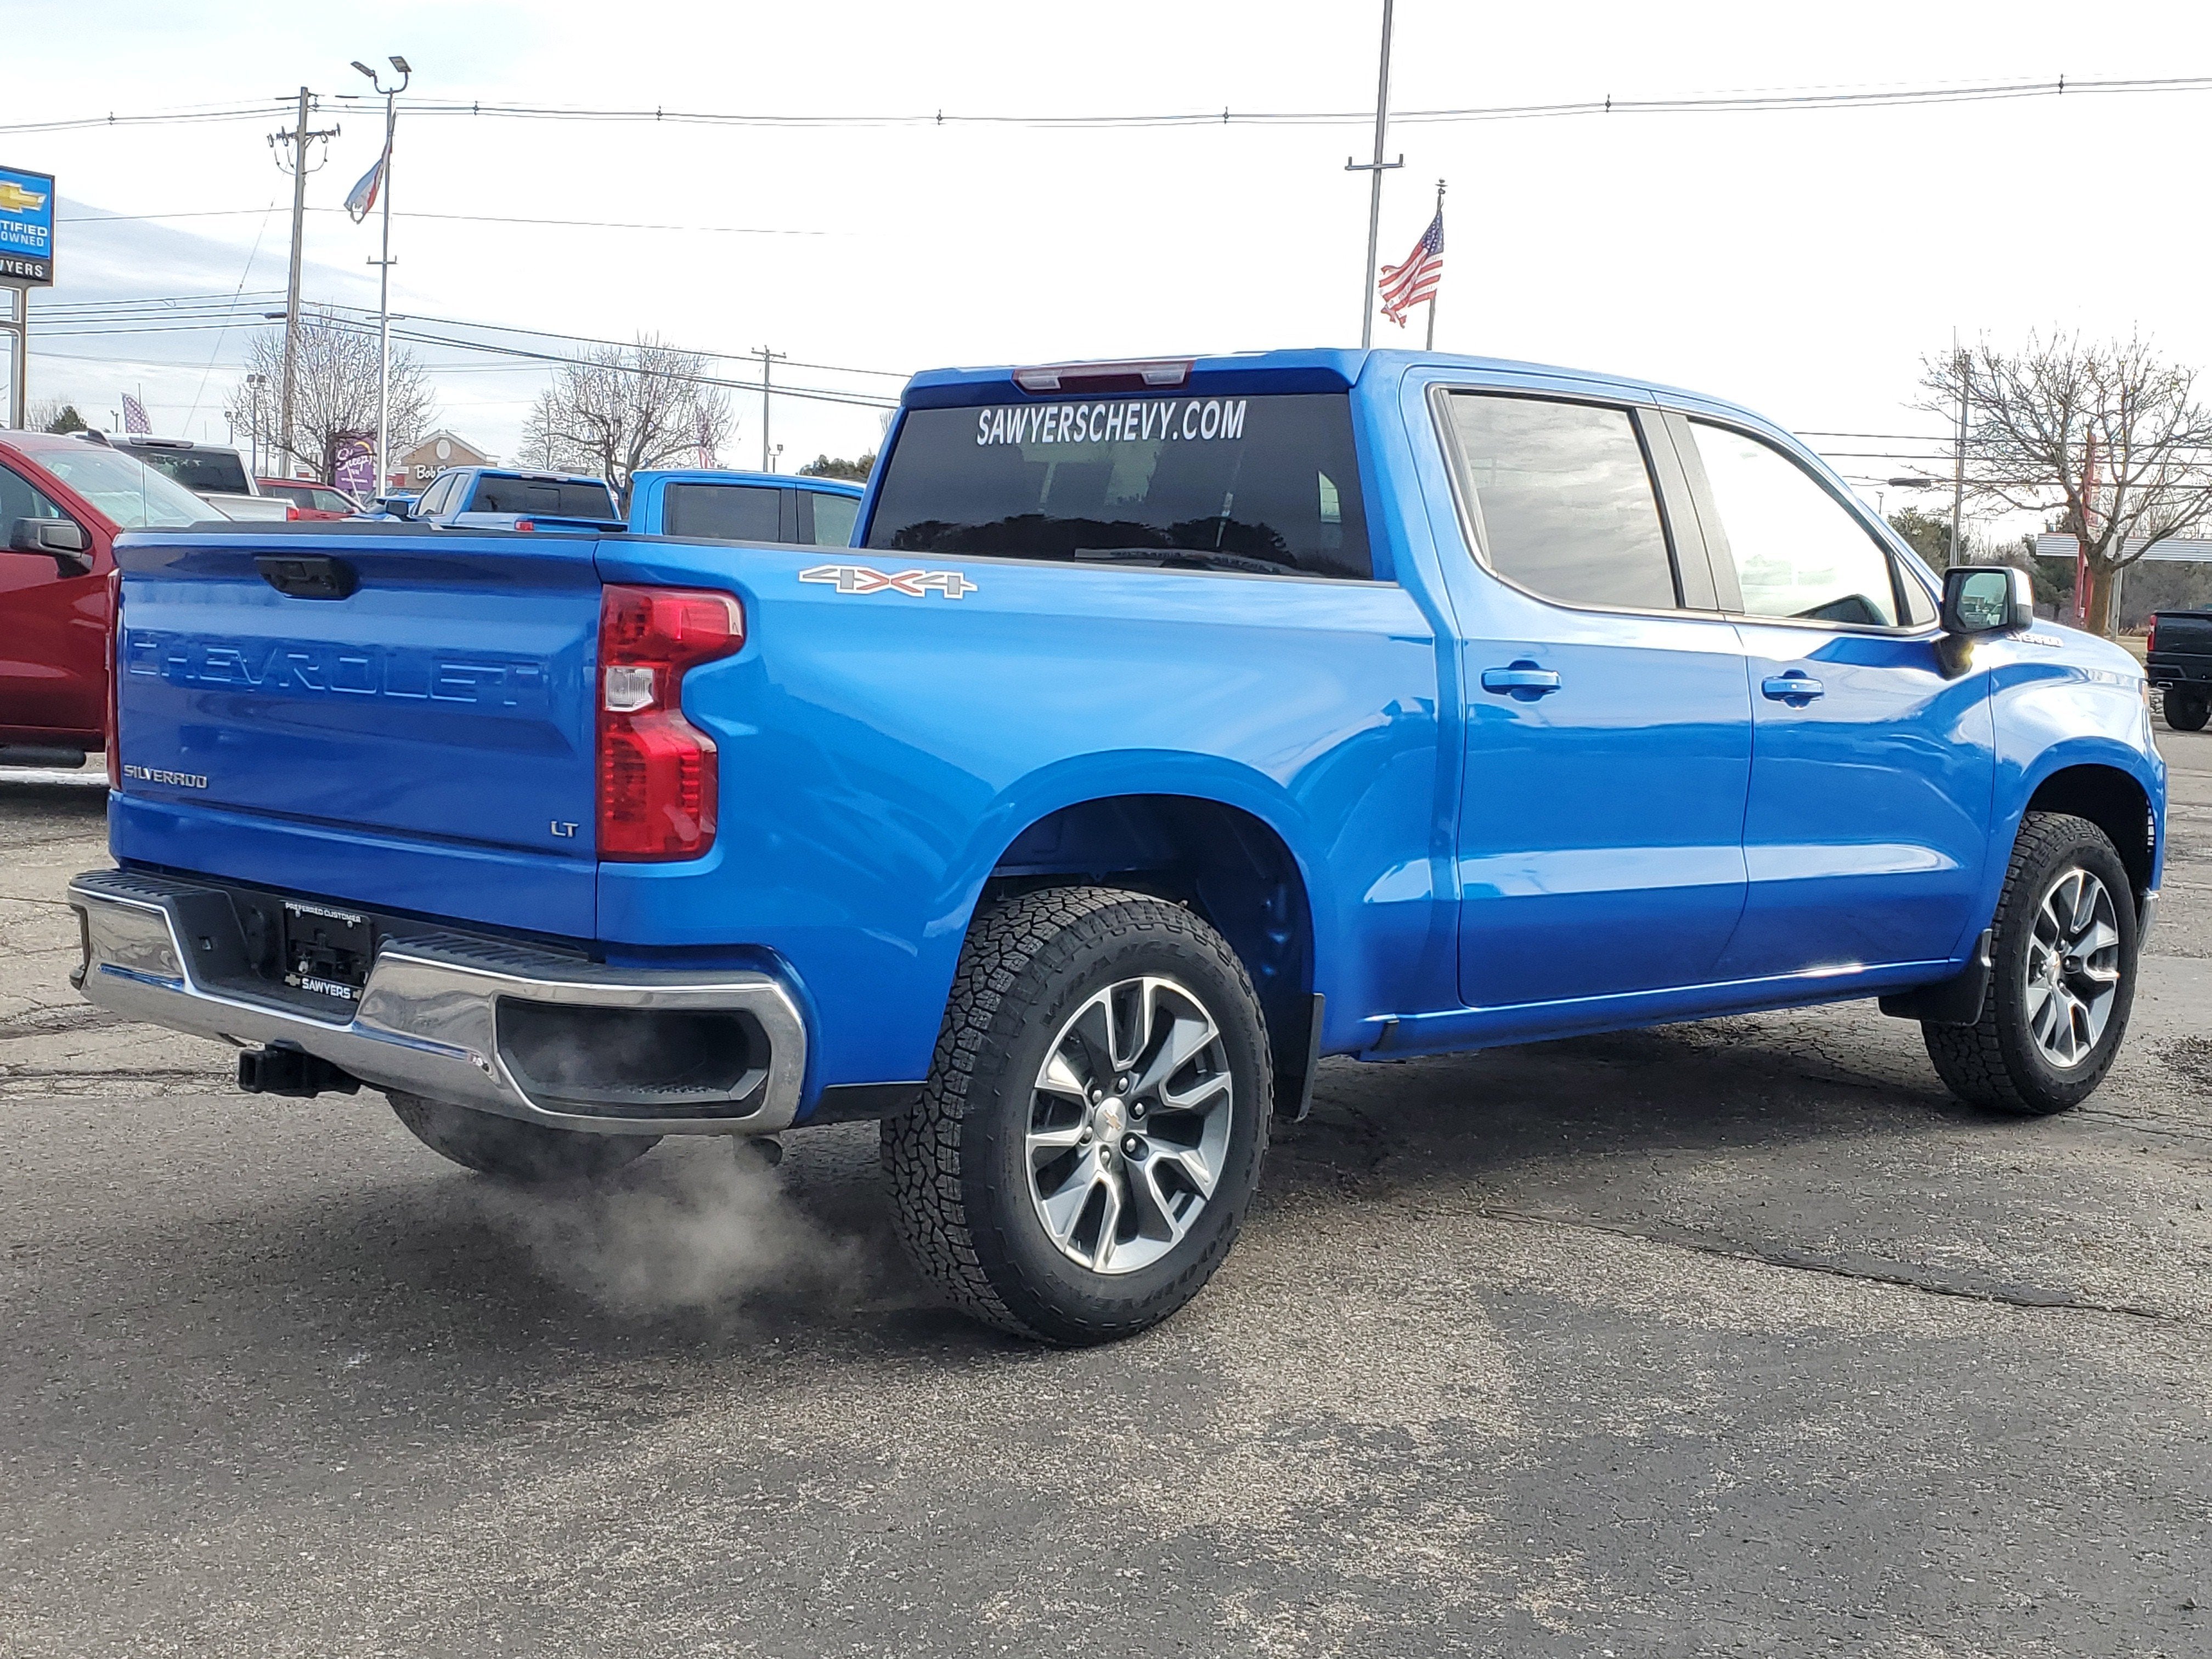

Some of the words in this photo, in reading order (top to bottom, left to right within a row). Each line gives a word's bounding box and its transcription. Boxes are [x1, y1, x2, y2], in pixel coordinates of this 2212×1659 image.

[0, 220, 47, 236] TIFIED
[1, 231, 44, 246] OWNED
[977, 400, 1246, 445] SAWYERSCHEVY.COM
[414, 464, 436, 479] Bob
[123, 764, 207, 789] SILVERADO
[551, 821, 579, 838] LT
[324, 910, 362, 923] CUSTOMER
[302, 978, 351, 999] SAWYERS
